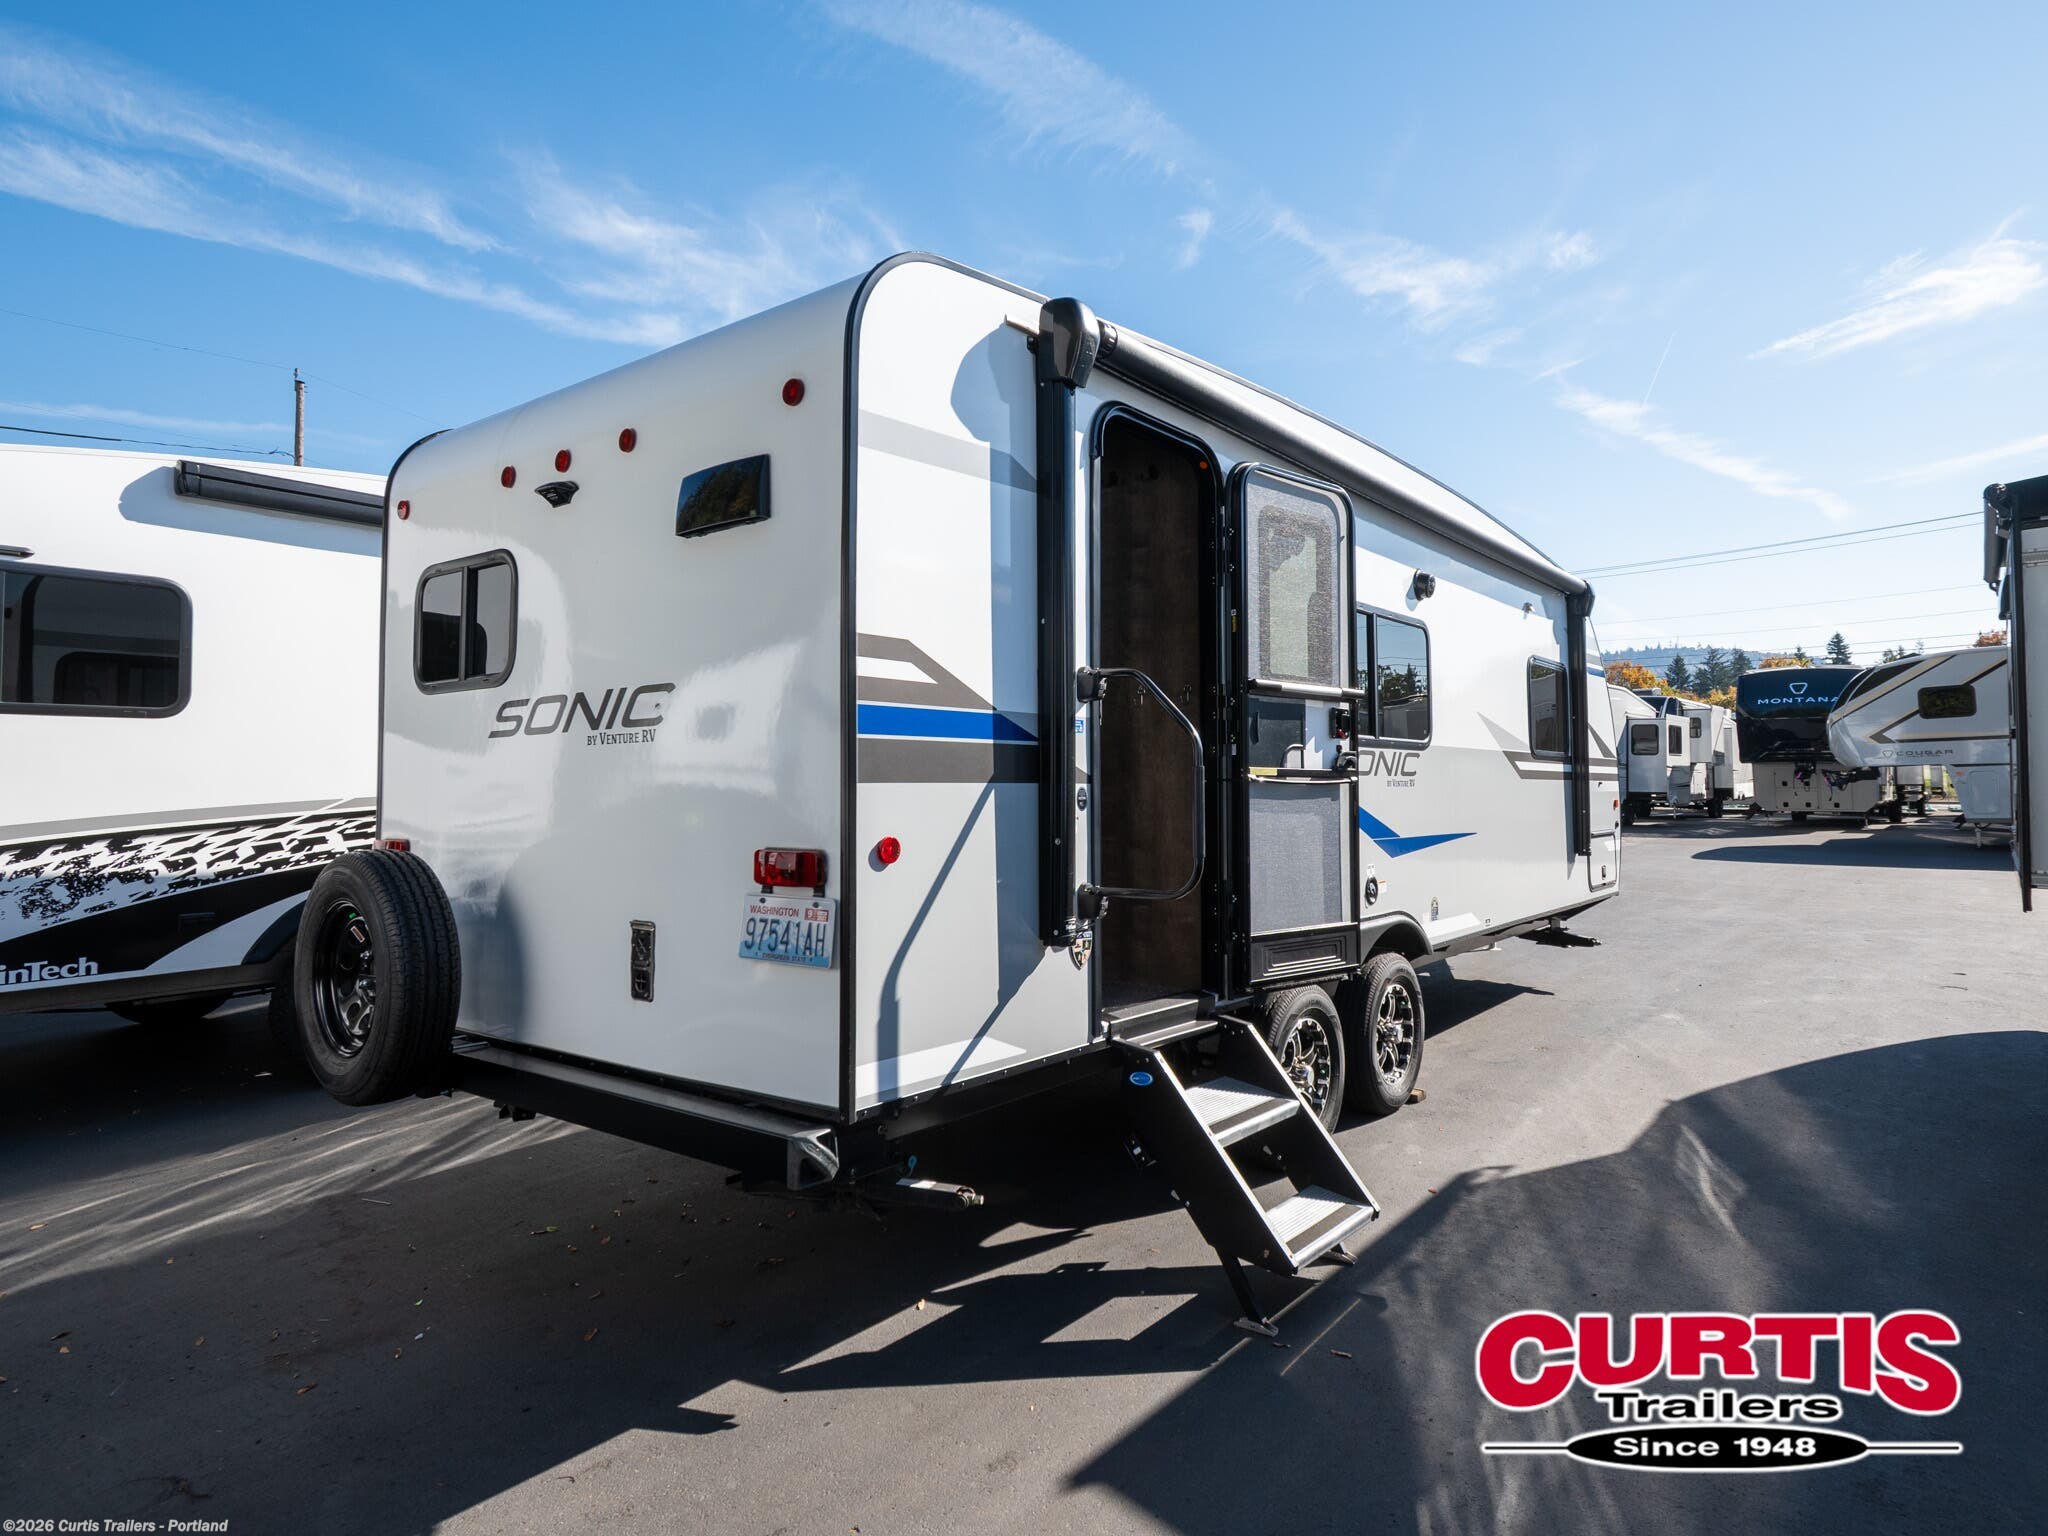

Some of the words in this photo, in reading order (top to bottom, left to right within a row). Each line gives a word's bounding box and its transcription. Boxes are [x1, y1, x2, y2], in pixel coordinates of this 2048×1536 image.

[488, 682, 676, 739] SONIC
[587, 735, 598, 746] BY
[642, 729, 657, 743] RV
[1358, 749, 1421, 777] ONIC
[1896, 749, 1954, 757] COUGAR
[750, 904, 800, 917] WASHINGTON
[744, 917, 827, 957] 97541AH
